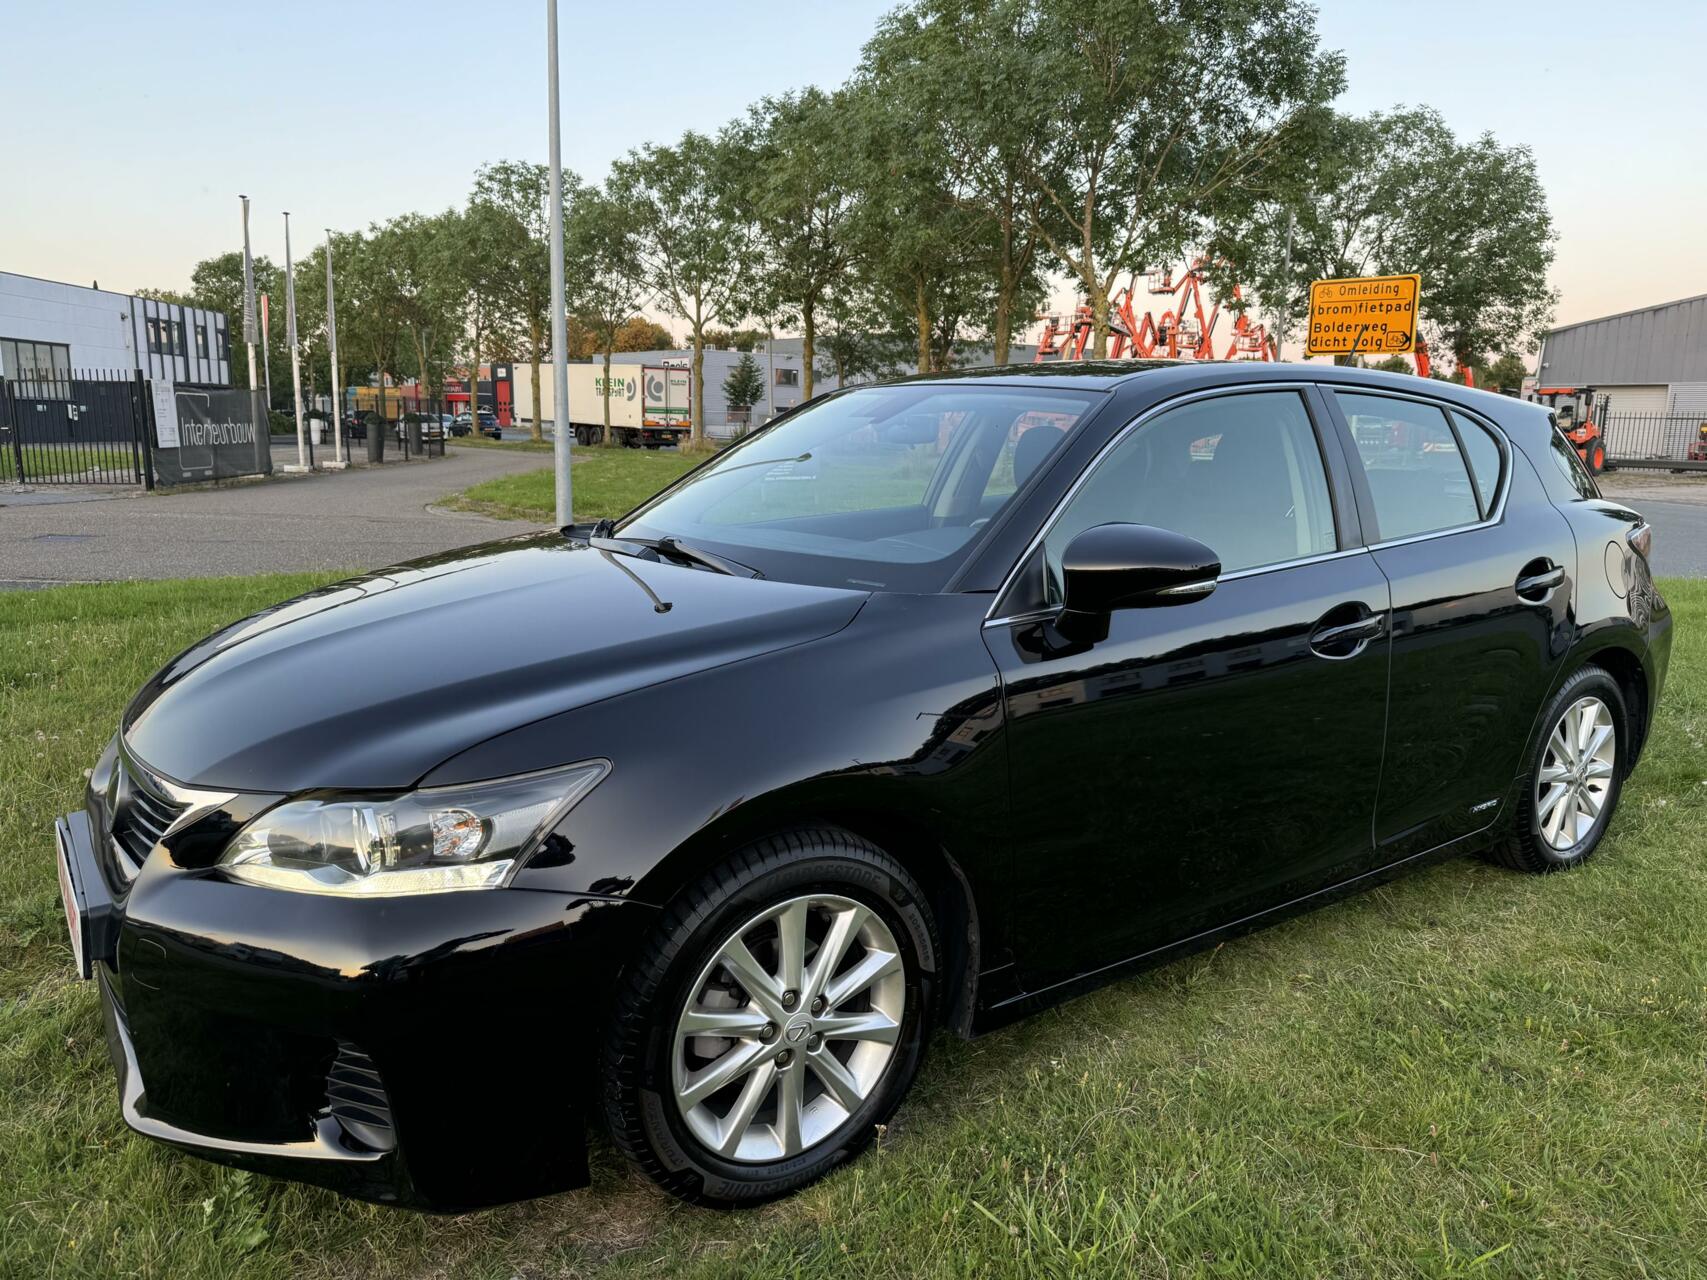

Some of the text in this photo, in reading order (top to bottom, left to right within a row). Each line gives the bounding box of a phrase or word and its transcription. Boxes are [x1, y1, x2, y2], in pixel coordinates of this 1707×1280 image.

[1339, 283, 1399, 296] Omleiding
[1313, 300, 1411, 318] (brom)fietpad
[1314, 322, 1388, 335] Bolderweg
[1311, 336, 1347, 348] dicht
[595, 377, 625, 387] KEIN
[181, 416, 256, 447] Interieurbouw
